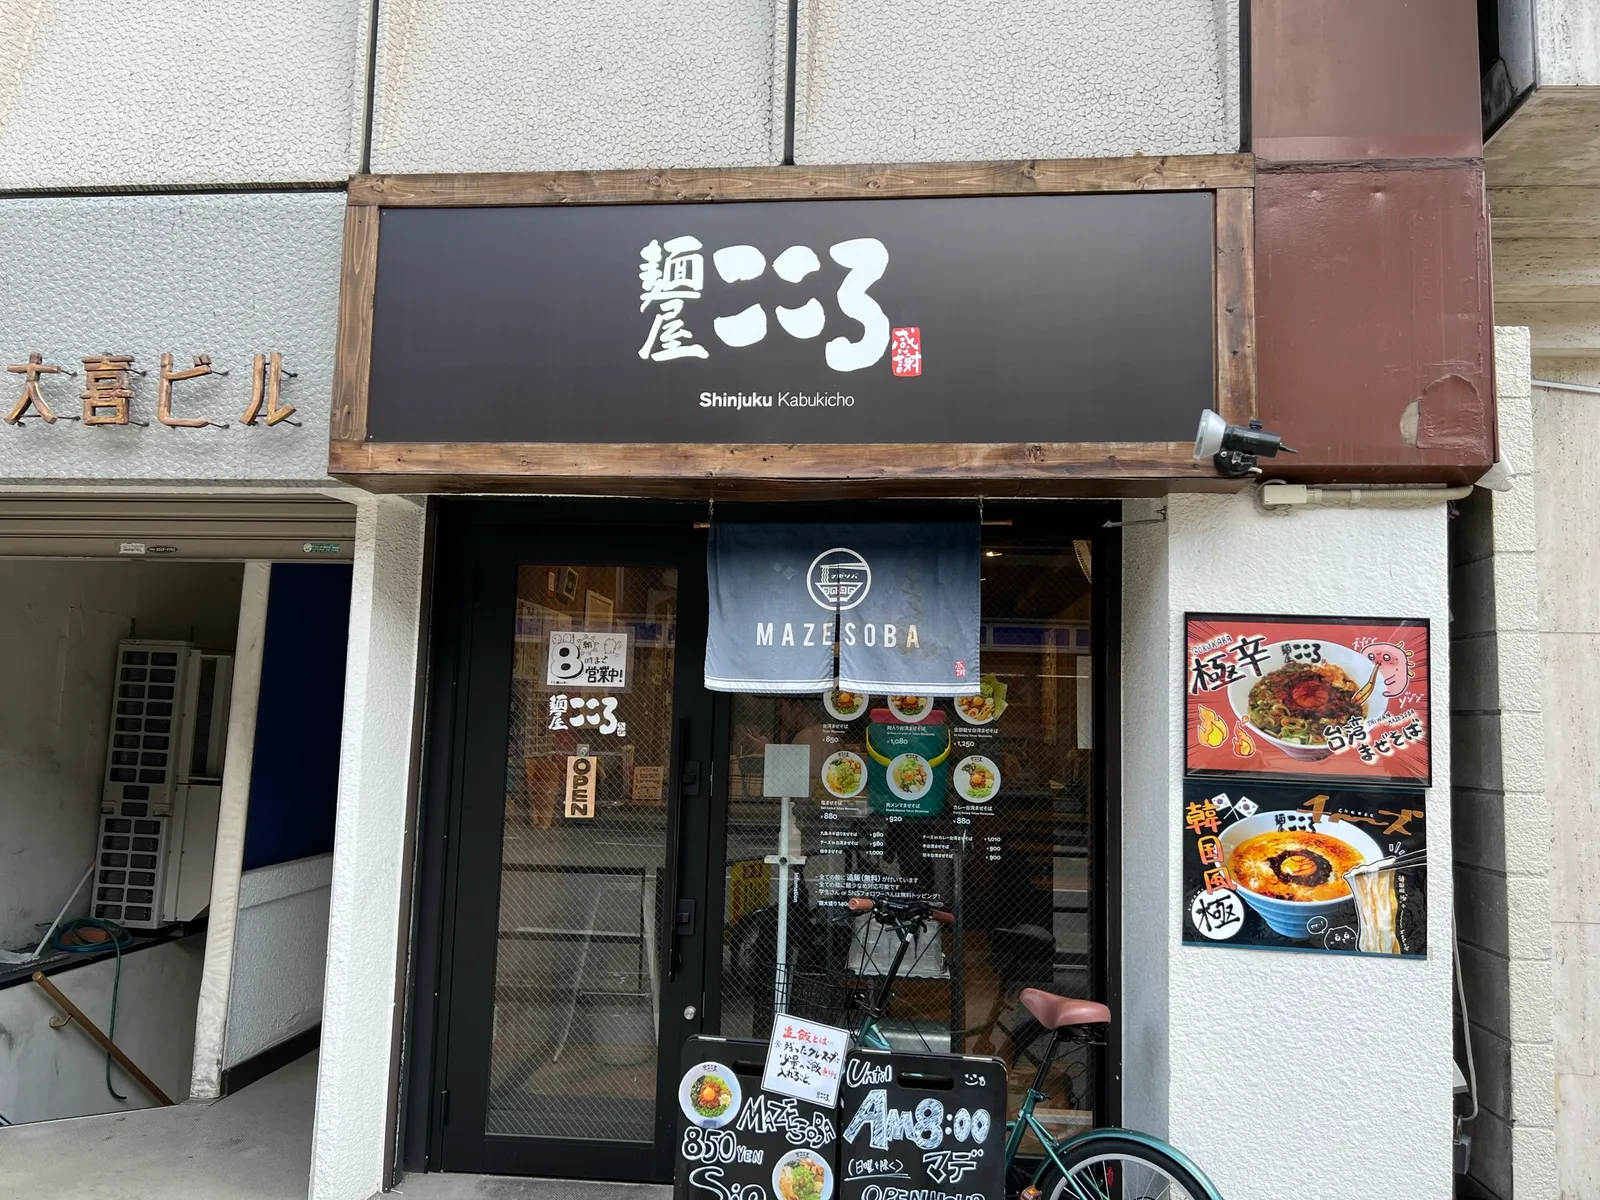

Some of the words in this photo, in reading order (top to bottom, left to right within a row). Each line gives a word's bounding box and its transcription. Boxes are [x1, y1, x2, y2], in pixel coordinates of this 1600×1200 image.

[712, 238, 890, 372] こころ
[893, 328, 922, 374] 感謝
[3, 352, 297, 428] 大喜ビル
[699, 392, 773, 410] Shinjuku
[777, 392, 855, 408] Kabukicho
[585, 666, 623, 683] 営業中!
[1191, 637, 1271, 695] 極辛
[569, 696, 618, 735] こころ
[1324, 716, 1367, 751] 台湾
[1358, 718, 1423, 761] まぜそば
[571, 757, 591, 816] OPEN
[1186, 800, 1238, 894] 韓国風
[1195, 894, 1241, 932] 極
[847, 1058, 893, 1088] Until
[922, 1149, 984, 1184] マデ
